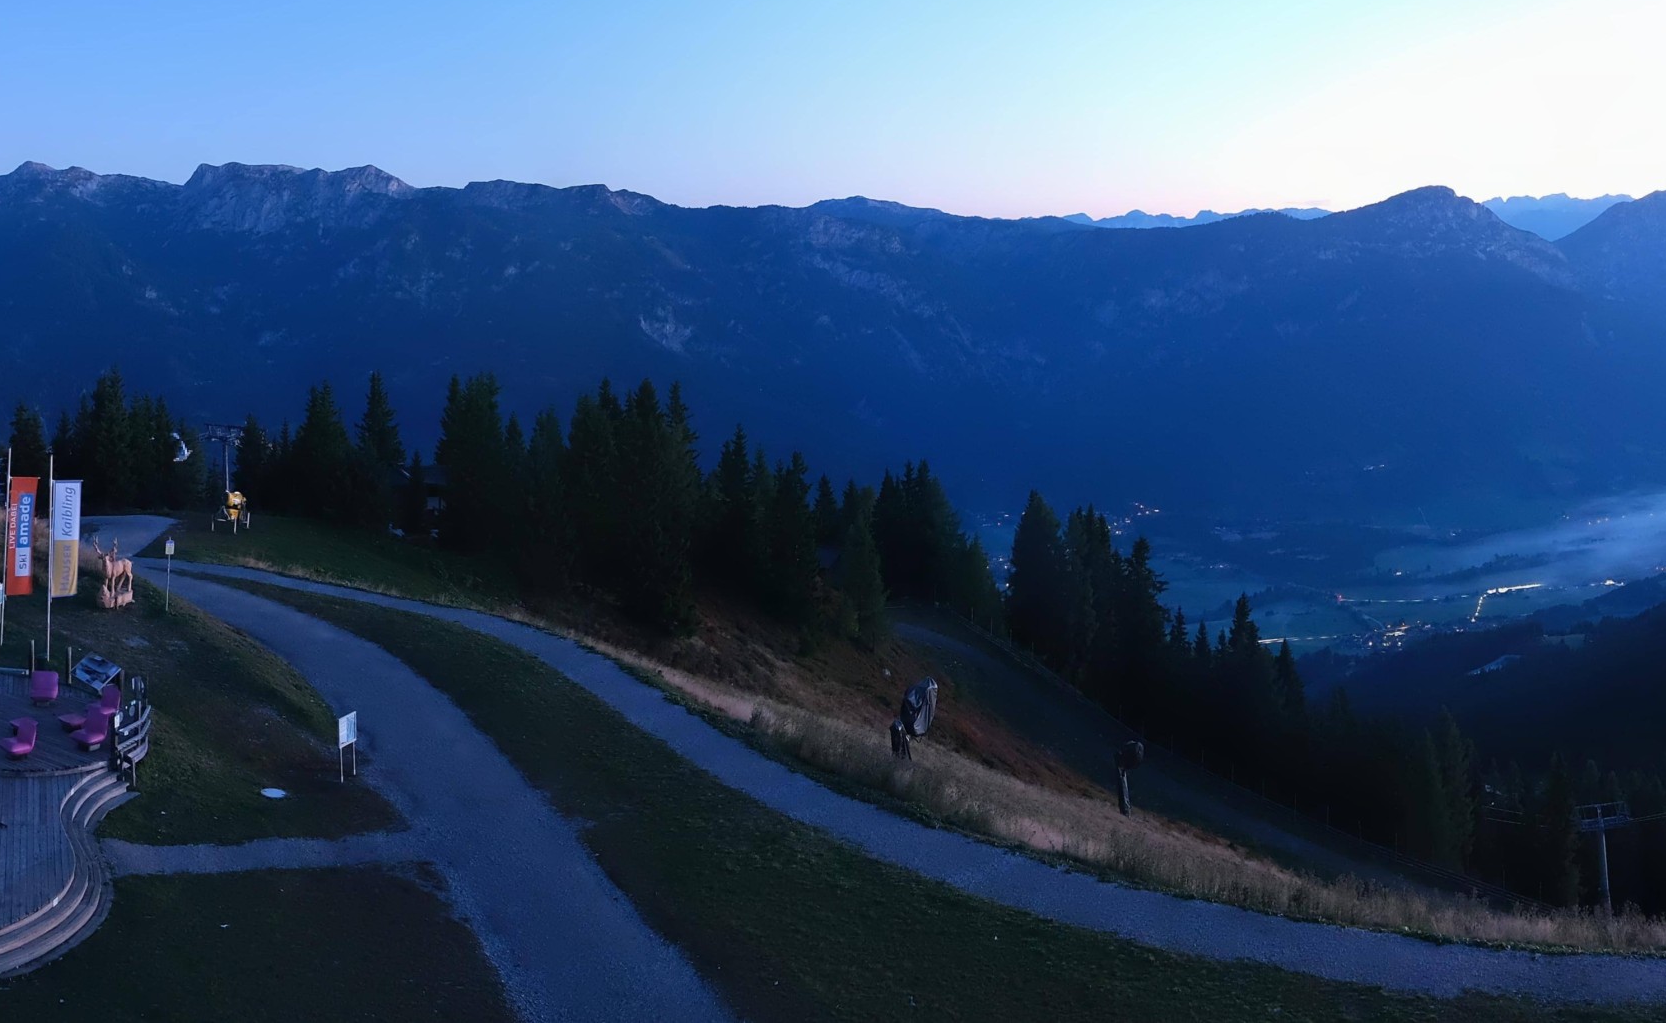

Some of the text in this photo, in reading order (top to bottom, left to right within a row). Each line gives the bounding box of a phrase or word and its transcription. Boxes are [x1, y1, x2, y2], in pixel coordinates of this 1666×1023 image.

[10, 503, 18, 528] DABEI
[19, 496, 31, 570] Ski amade
[61, 487, 76, 537] Kaibling
